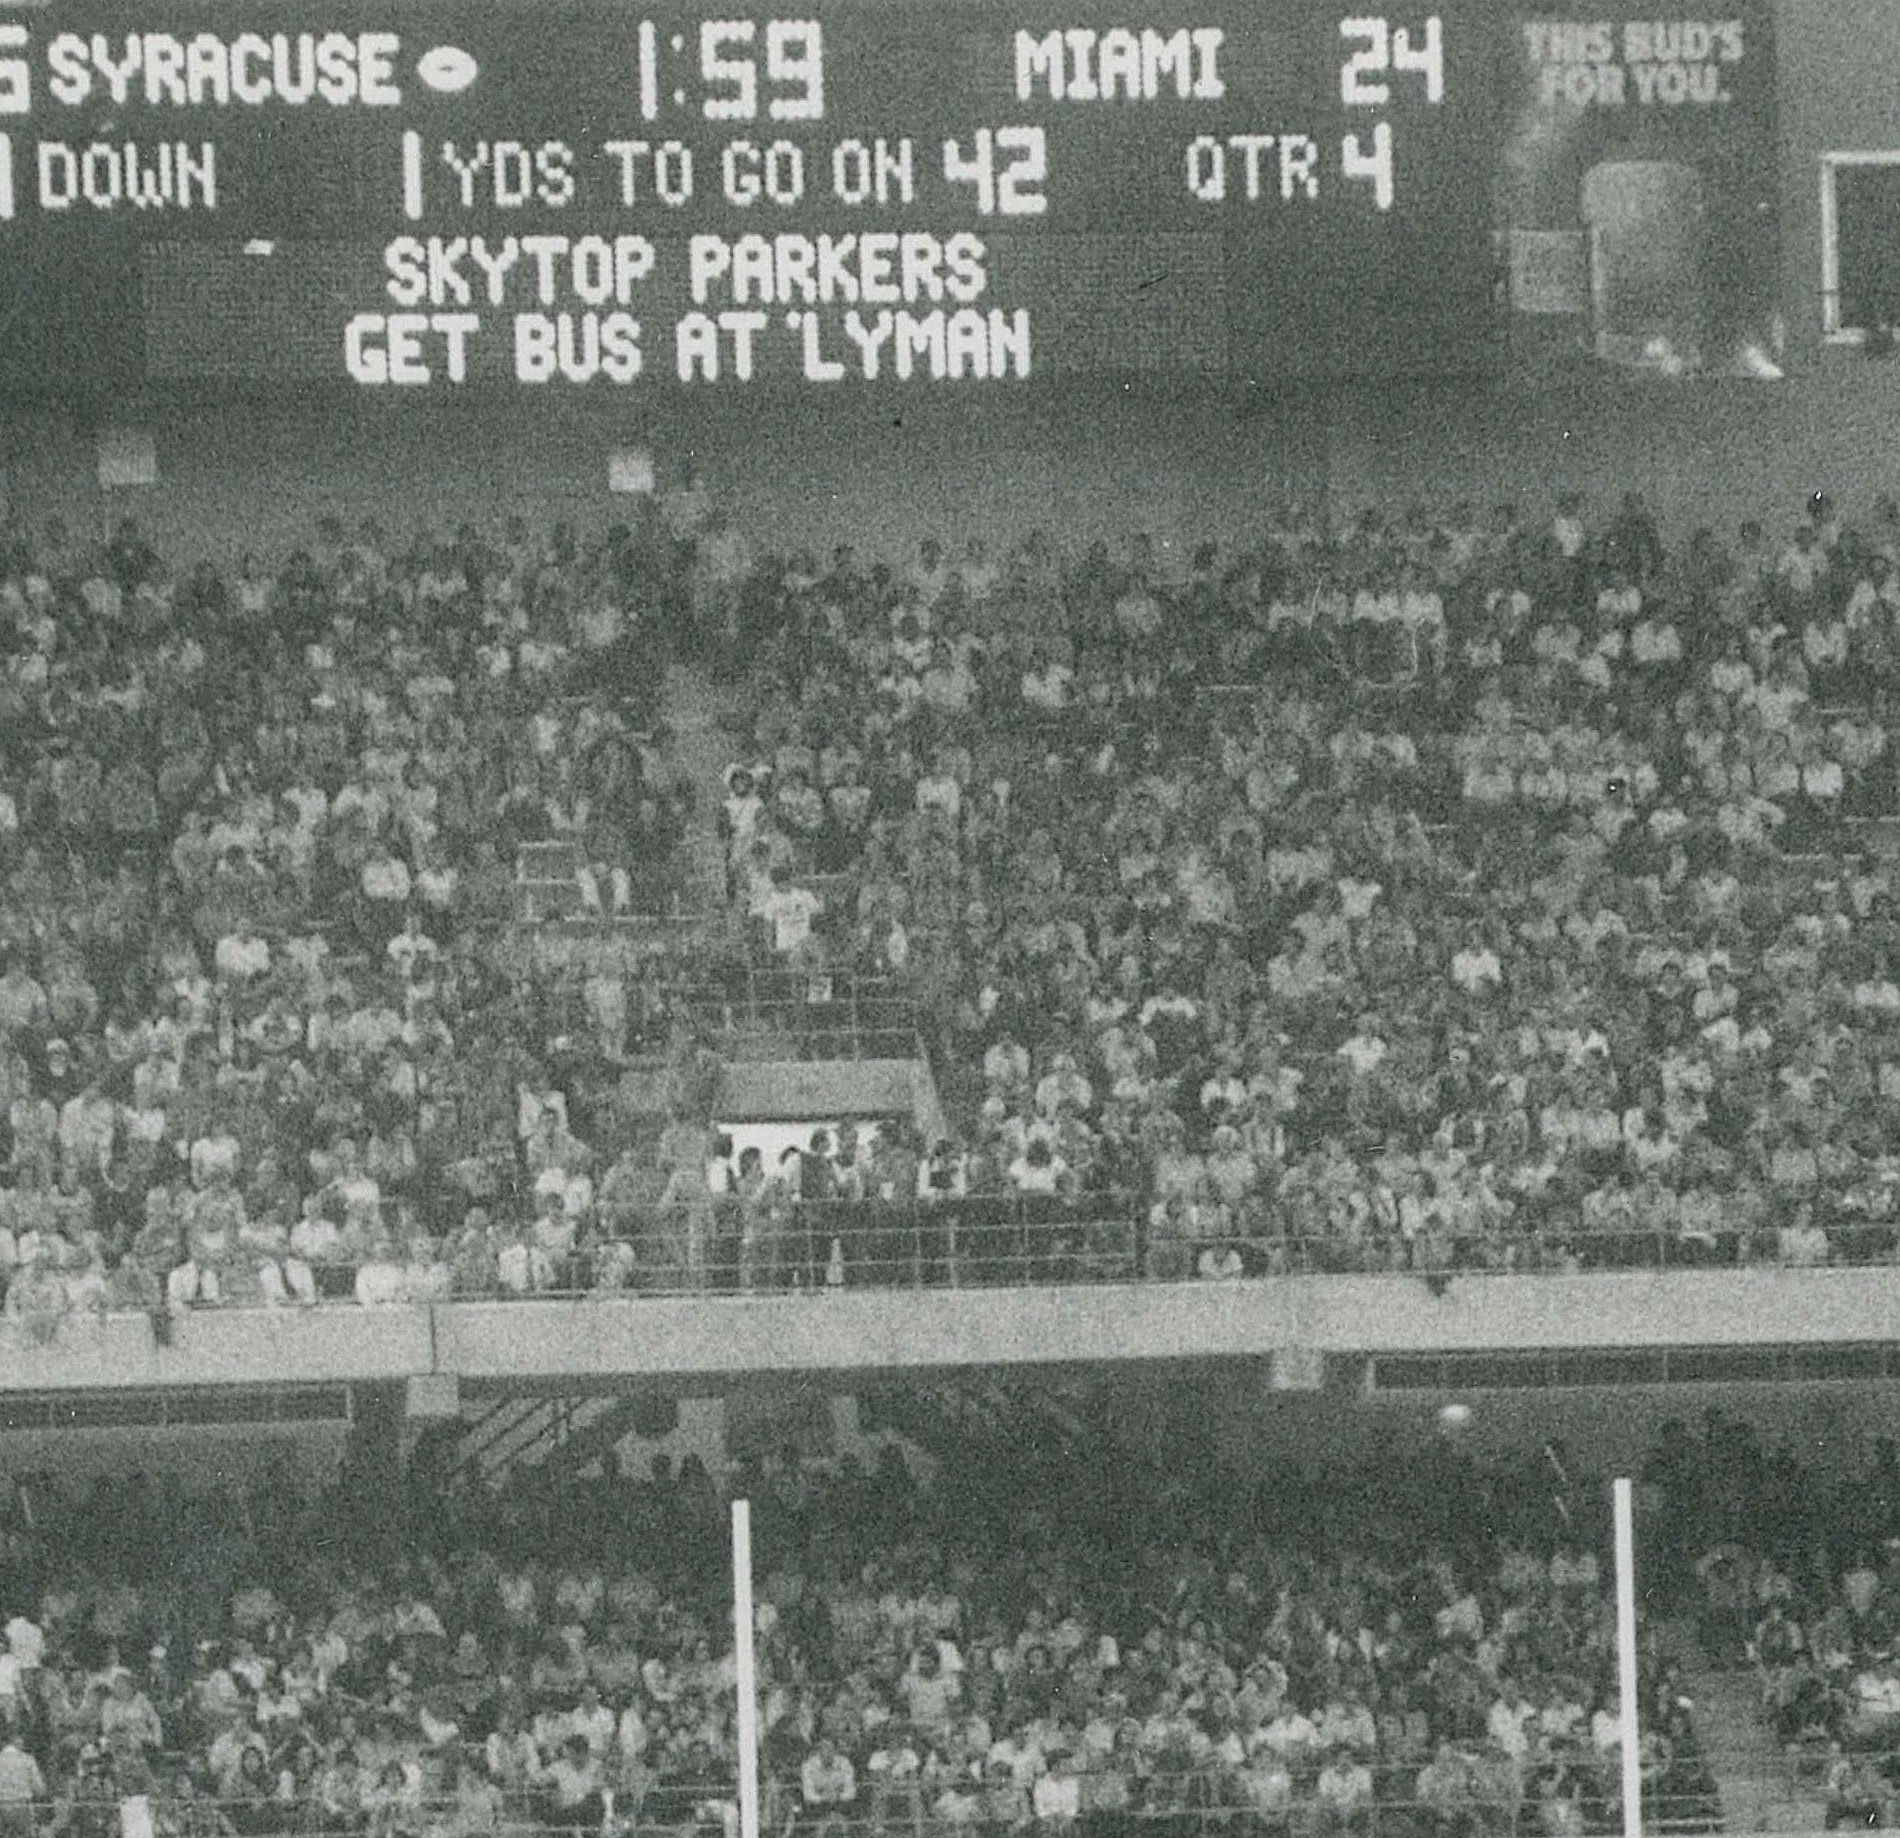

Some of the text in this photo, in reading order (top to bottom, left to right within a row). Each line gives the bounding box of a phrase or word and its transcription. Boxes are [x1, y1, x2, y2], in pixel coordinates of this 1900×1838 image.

[47, 31, 403, 107] SYRACUSE
[637, 18, 826, 122] 1:59
[1013, 27, 1226, 102] MIAMI
[1338, 15, 1445, 106] 24
[1522, 20, 1746, 62] THIS BUD'S
[1538, 64, 1732, 104] FOR YOU.
[37, 141, 216, 209] DOWN
[401, 129, 424, 221] 1
[442, 140, 575, 208] YDS
[603, 140, 694, 207] TO
[721, 139, 805, 207] GO
[832, 137, 915, 206] ON
[942, 125, 1048, 216] 42
[1186, 134, 1319, 201] QTR
[1340, 120, 1394, 210] 4
[383, 231, 988, 307] SKYTOP PARKERS
[343, 312, 481, 385] GET
[513, 310, 644, 384] BUS
[674, 310, 769, 383] AT
